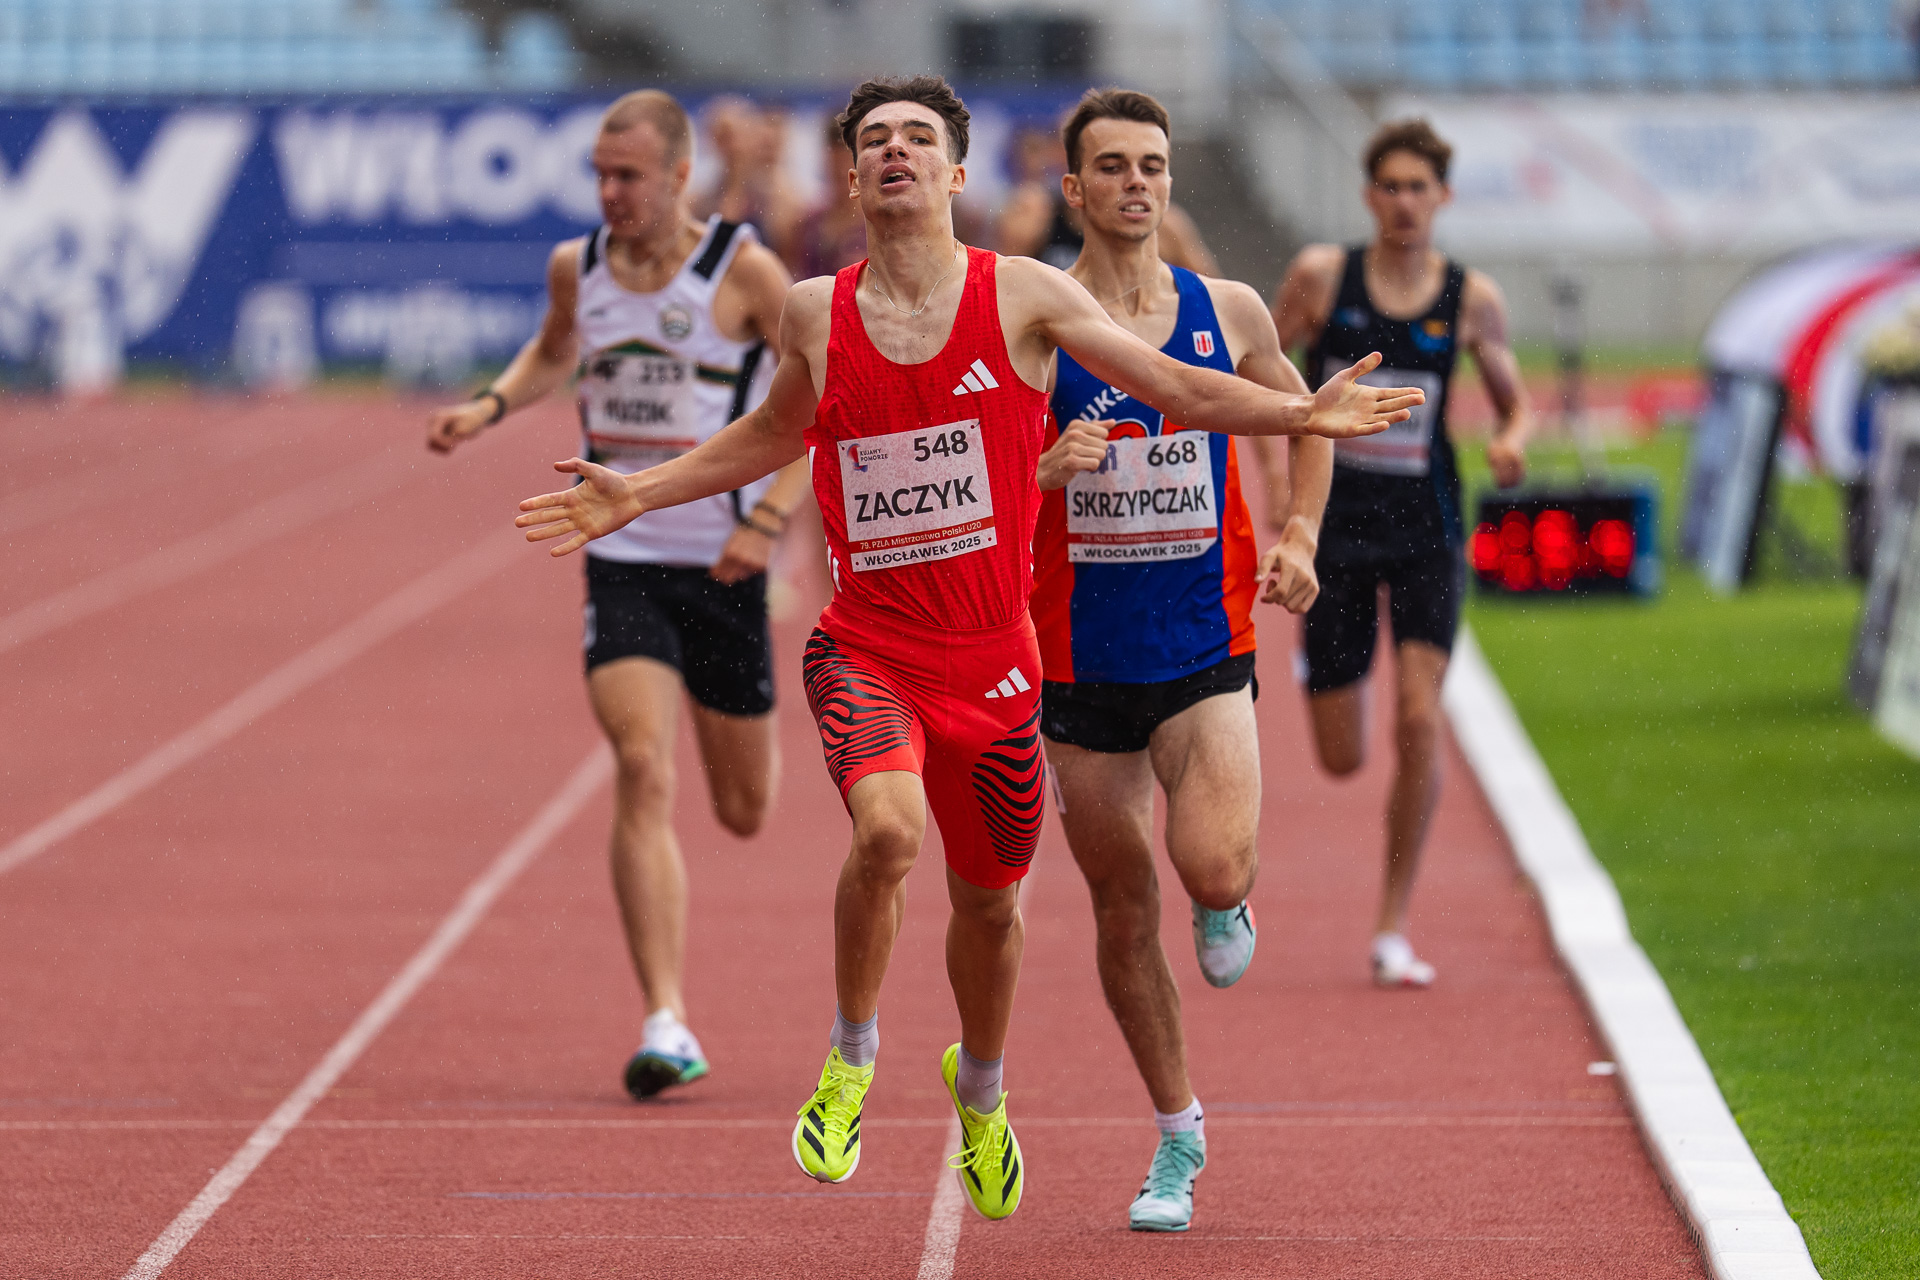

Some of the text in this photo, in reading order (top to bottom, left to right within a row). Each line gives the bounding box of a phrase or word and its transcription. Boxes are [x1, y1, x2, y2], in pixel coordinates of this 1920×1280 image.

[860, 448, 881, 456] KUJAWY
[860, 454, 888, 462] POMORZE
[913, 430, 969, 462] 548
[1147, 440, 1197, 467] 668
[854, 475, 978, 523] ZACZYK
[1072, 485, 1208, 518] SKRZYPCZAK
[860, 521, 982, 550] 79. PZLA Mistrzostwa Polski U20
[864, 536, 981, 567] WŁOCŁAWEK 2025
[1083, 543, 1201, 558] WŁOCŁAWEK 2025
